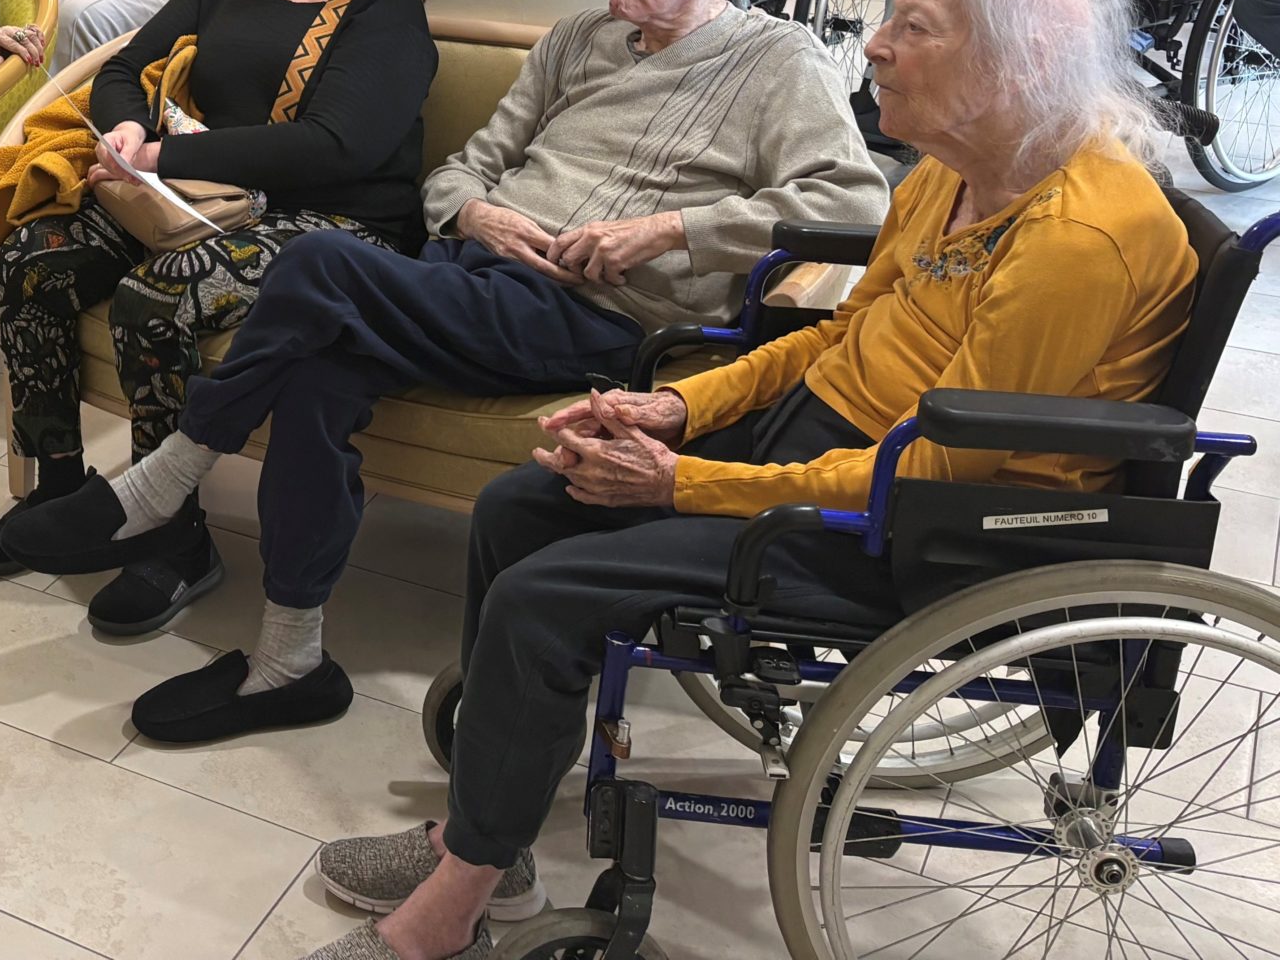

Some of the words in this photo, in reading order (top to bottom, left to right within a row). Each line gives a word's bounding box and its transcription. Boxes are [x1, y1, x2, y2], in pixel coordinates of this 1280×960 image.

[994, 516, 1040, 526] FAUTEUIL
[1042, 512, 1084, 523] NUMERO
[1087, 512, 1097, 520] 10
[665, 797, 714, 814] Action
[720, 803, 755, 819] 2000
